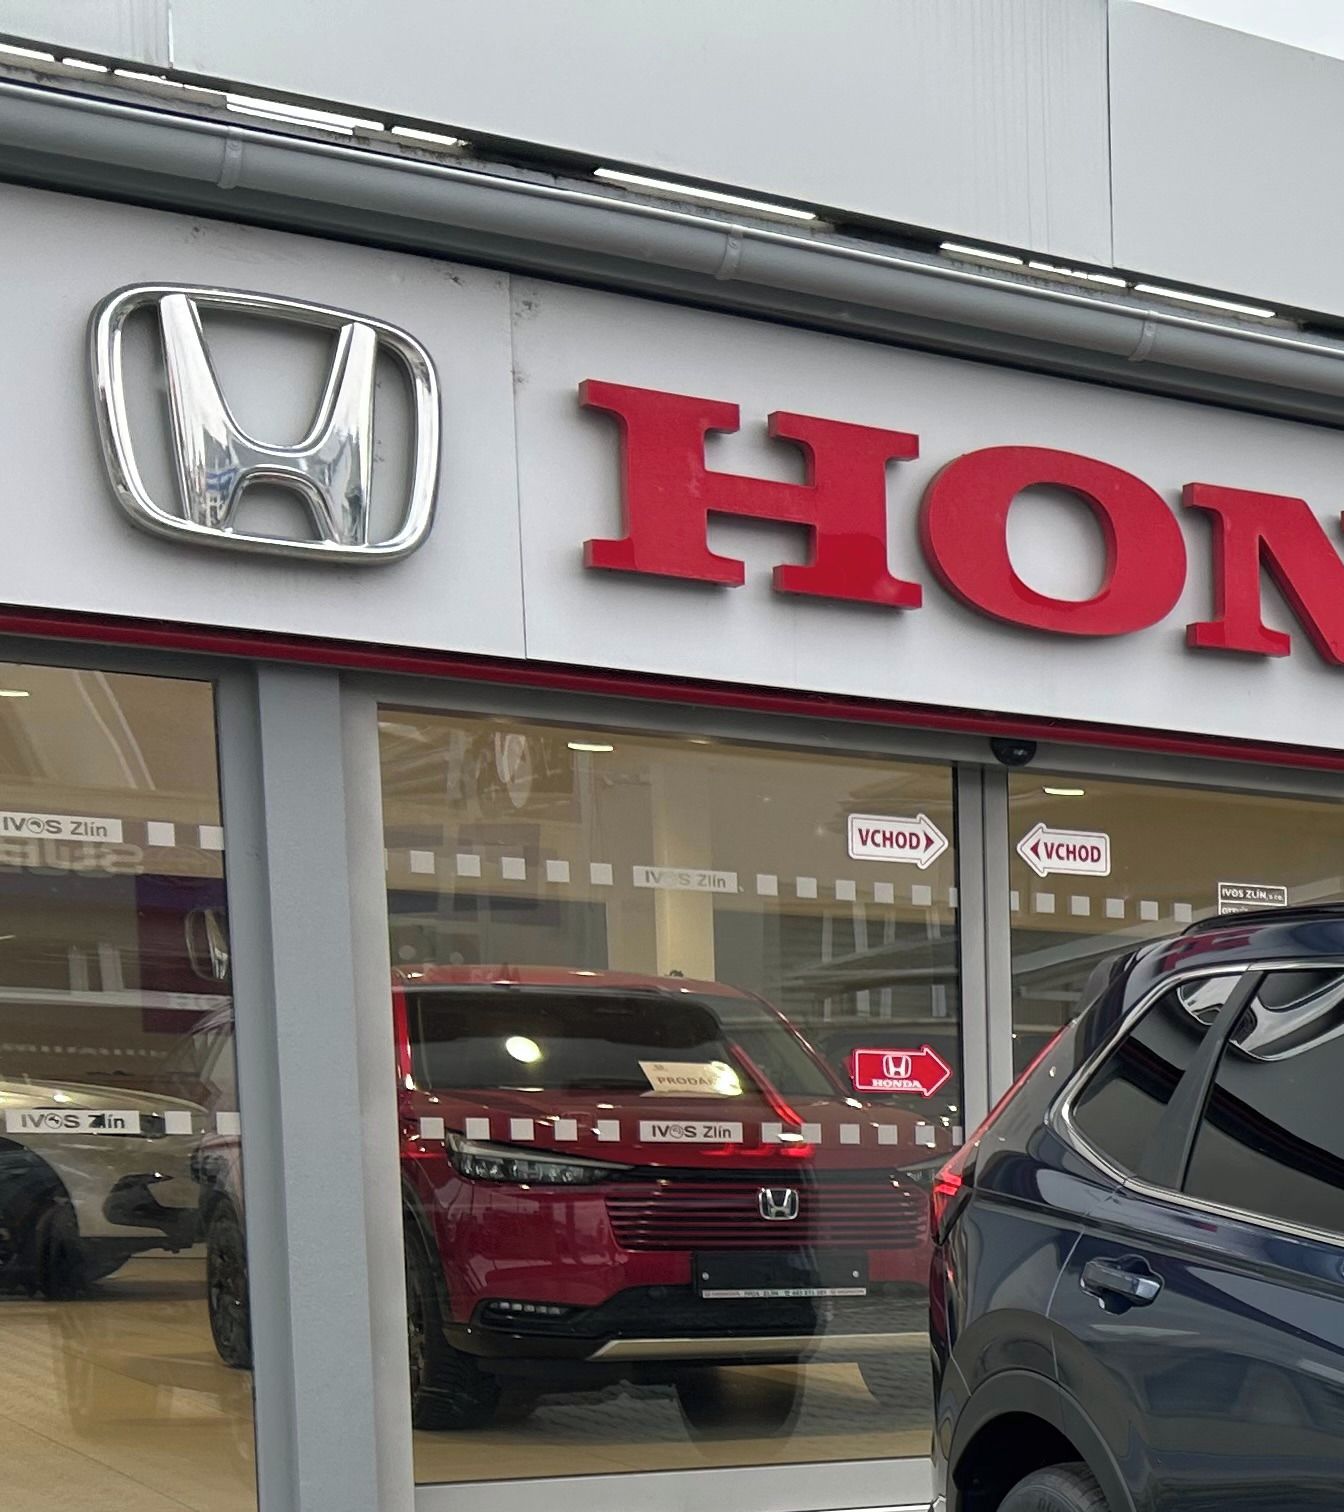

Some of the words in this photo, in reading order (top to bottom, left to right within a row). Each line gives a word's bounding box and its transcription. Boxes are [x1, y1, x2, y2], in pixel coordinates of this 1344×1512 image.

[70, 821, 108, 838] Zlín
[858, 828, 921, 850] VCHOD
[1043, 841, 1101, 863] VCHOD
[645, 869, 690, 887] IVS
[696, 873, 727, 889] Zlín
[1222, 888, 1244, 898] IVOS
[872, 1079, 923, 1088] HONDA
[703, 1125, 731, 1139] Zlín
